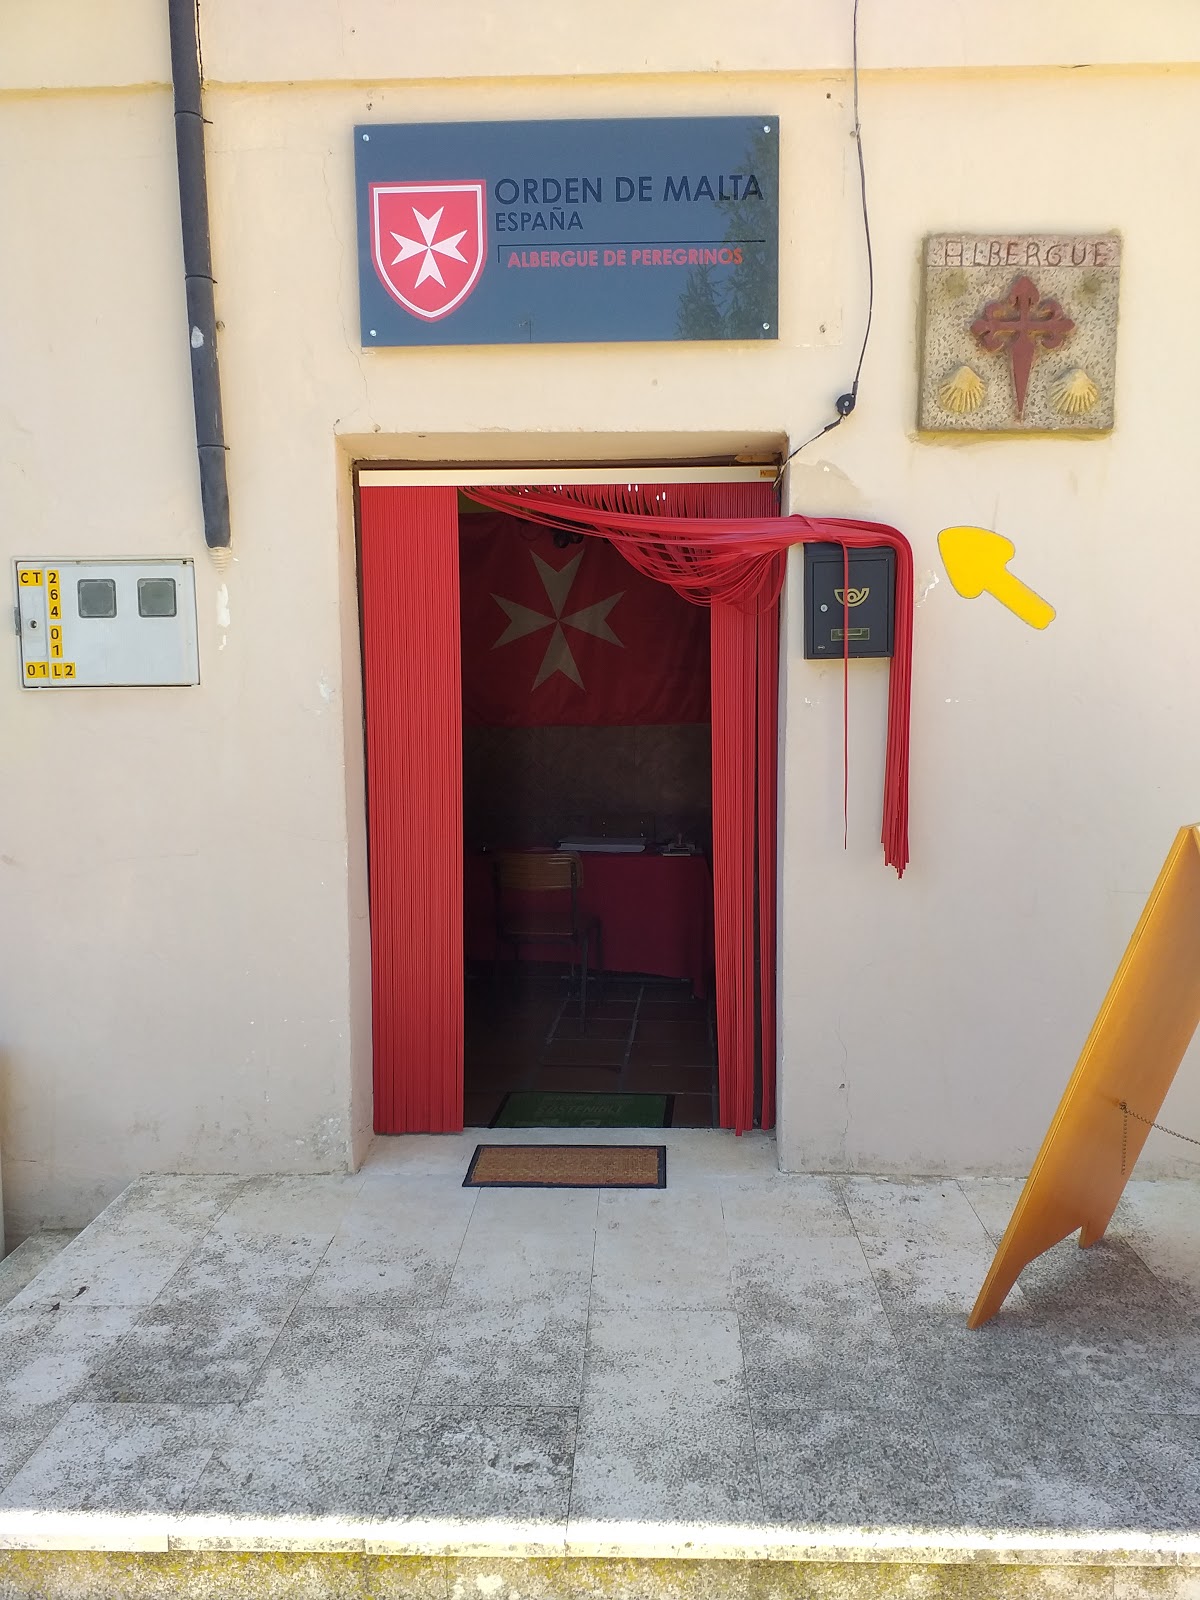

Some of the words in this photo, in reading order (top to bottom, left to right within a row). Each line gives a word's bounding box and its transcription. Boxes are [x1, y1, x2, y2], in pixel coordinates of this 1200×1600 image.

[494, 176, 601, 205] ORDEN
[615, 175, 652, 203] DE
[663, 174, 764, 202] MALTA
[495, 207, 584, 232] ESPAÑA
[507, 248, 599, 268] ALBERGUE
[604, 249, 627, 267] DE
[631, 247, 743, 267] PEREGRINOS
[944, 240, 1107, 267] ALBERGUE
